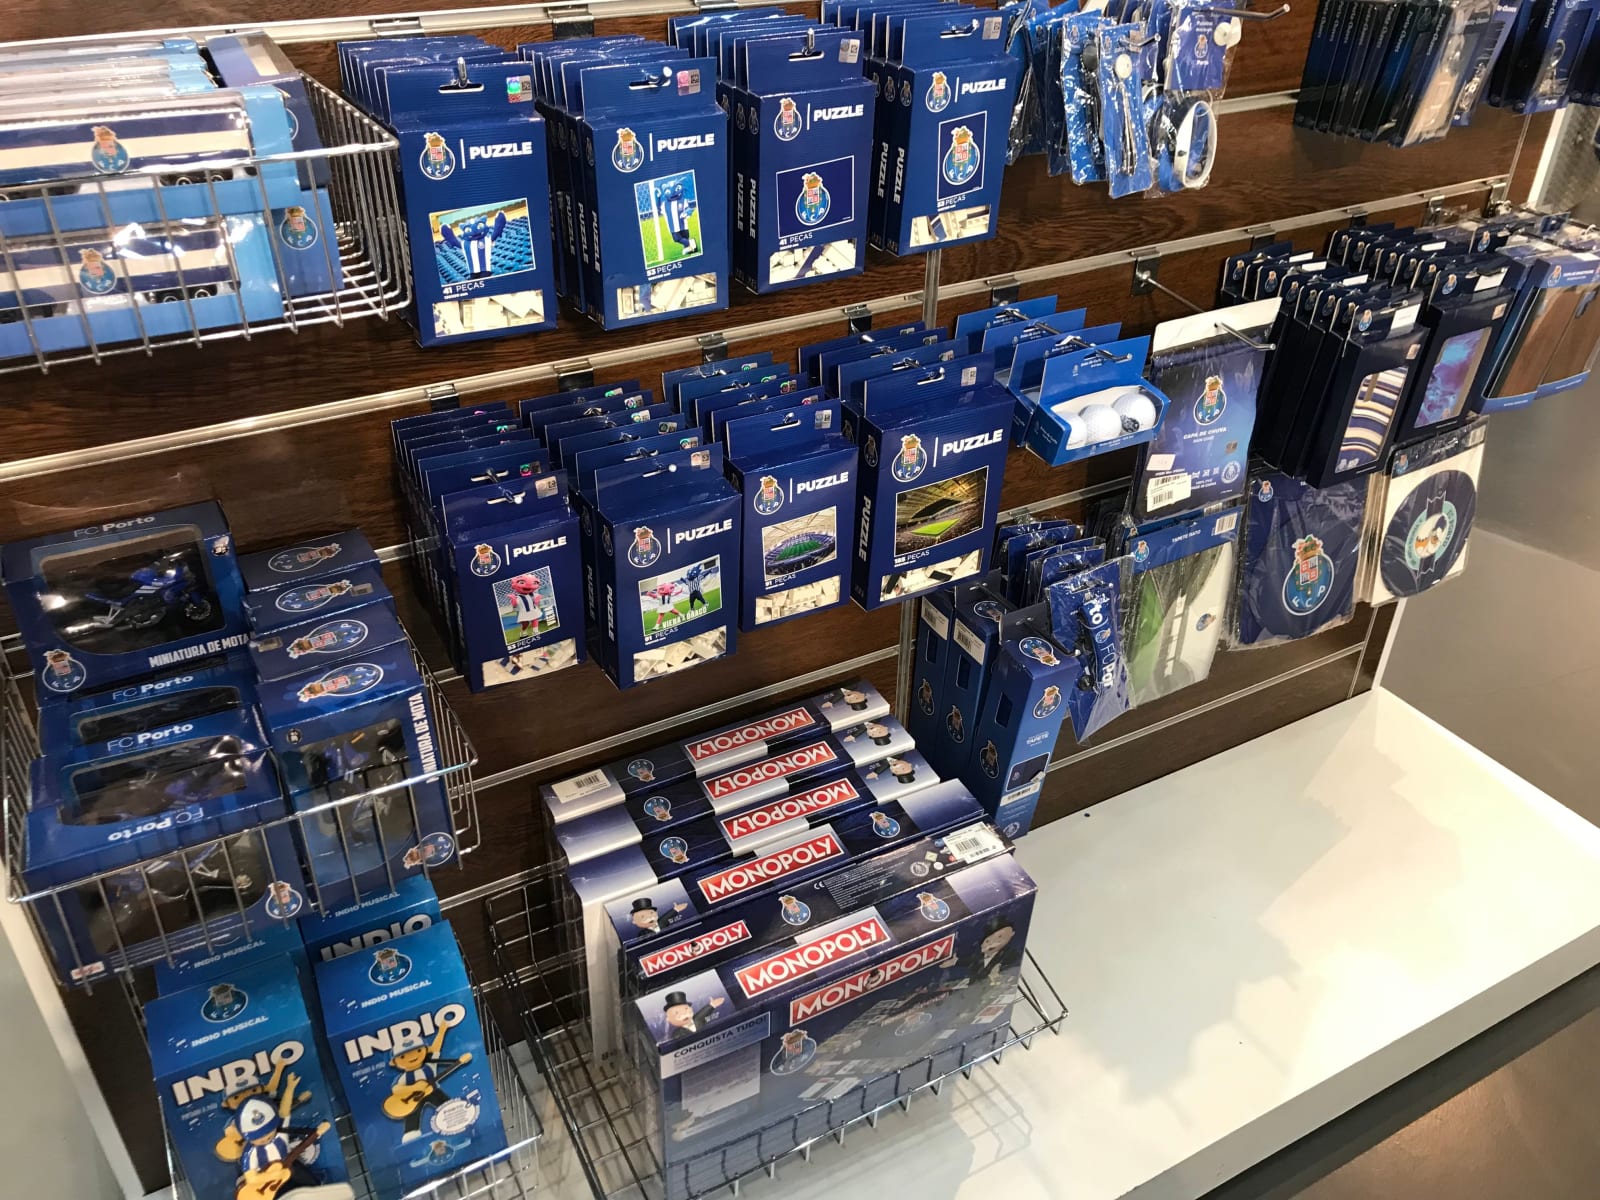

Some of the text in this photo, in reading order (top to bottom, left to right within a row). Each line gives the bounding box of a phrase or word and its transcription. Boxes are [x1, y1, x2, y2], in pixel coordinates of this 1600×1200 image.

[961, 78, 1006, 95] PUZZLE
[813, 104, 864, 123] PUZZLE
[469, 141, 533, 160] PUZZLE
[657, 133, 715, 152] PUZZLE
[877, 141, 889, 199] PUZZLE
[893, 147, 905, 205] PUZZLE
[749, 178, 757, 239] PUZZLE
[578, 202, 588, 264] PUZZLE
[591, 210, 600, 272] PUZZLE
[942, 429, 1004, 457] PUZZLE
[796, 471, 849, 494] PUZZLE
[102, 515, 156, 532] Porto
[675, 519, 733, 544] PUZZLE
[858, 495, 871, 562] PUZZLE
[513, 536, 567, 558] PUZZLE
[606, 583, 615, 642] PUZZLE
[149, 632, 249, 668] MINIATURA DE MOTA
[141, 675, 194, 693] Porto
[408, 692, 427, 720] MOTA
[137, 723, 194, 744] Porto
[413, 719, 430, 735] DE
[695, 710, 807, 759] MONOPOLY
[713, 744, 830, 799] MONOPOLY
[730, 781, 851, 837] MONOPOLY
[107, 817, 172, 842] Porto
[707, 836, 833, 899] MONOPOLY
[645, 922, 749, 974] MONOPOLY
[745, 922, 879, 991] MONOPOLY
[361, 979, 432, 1009] INDIO MUSICAL
[794, 939, 952, 1020] MONOPOLY
[191, 1015, 269, 1048] INDIO MUSICAL
[343, 1002, 467, 1064] INDIO
[673, 1029, 734, 1058] CONQUISTA
[170, 1039, 305, 1107] INDIO
